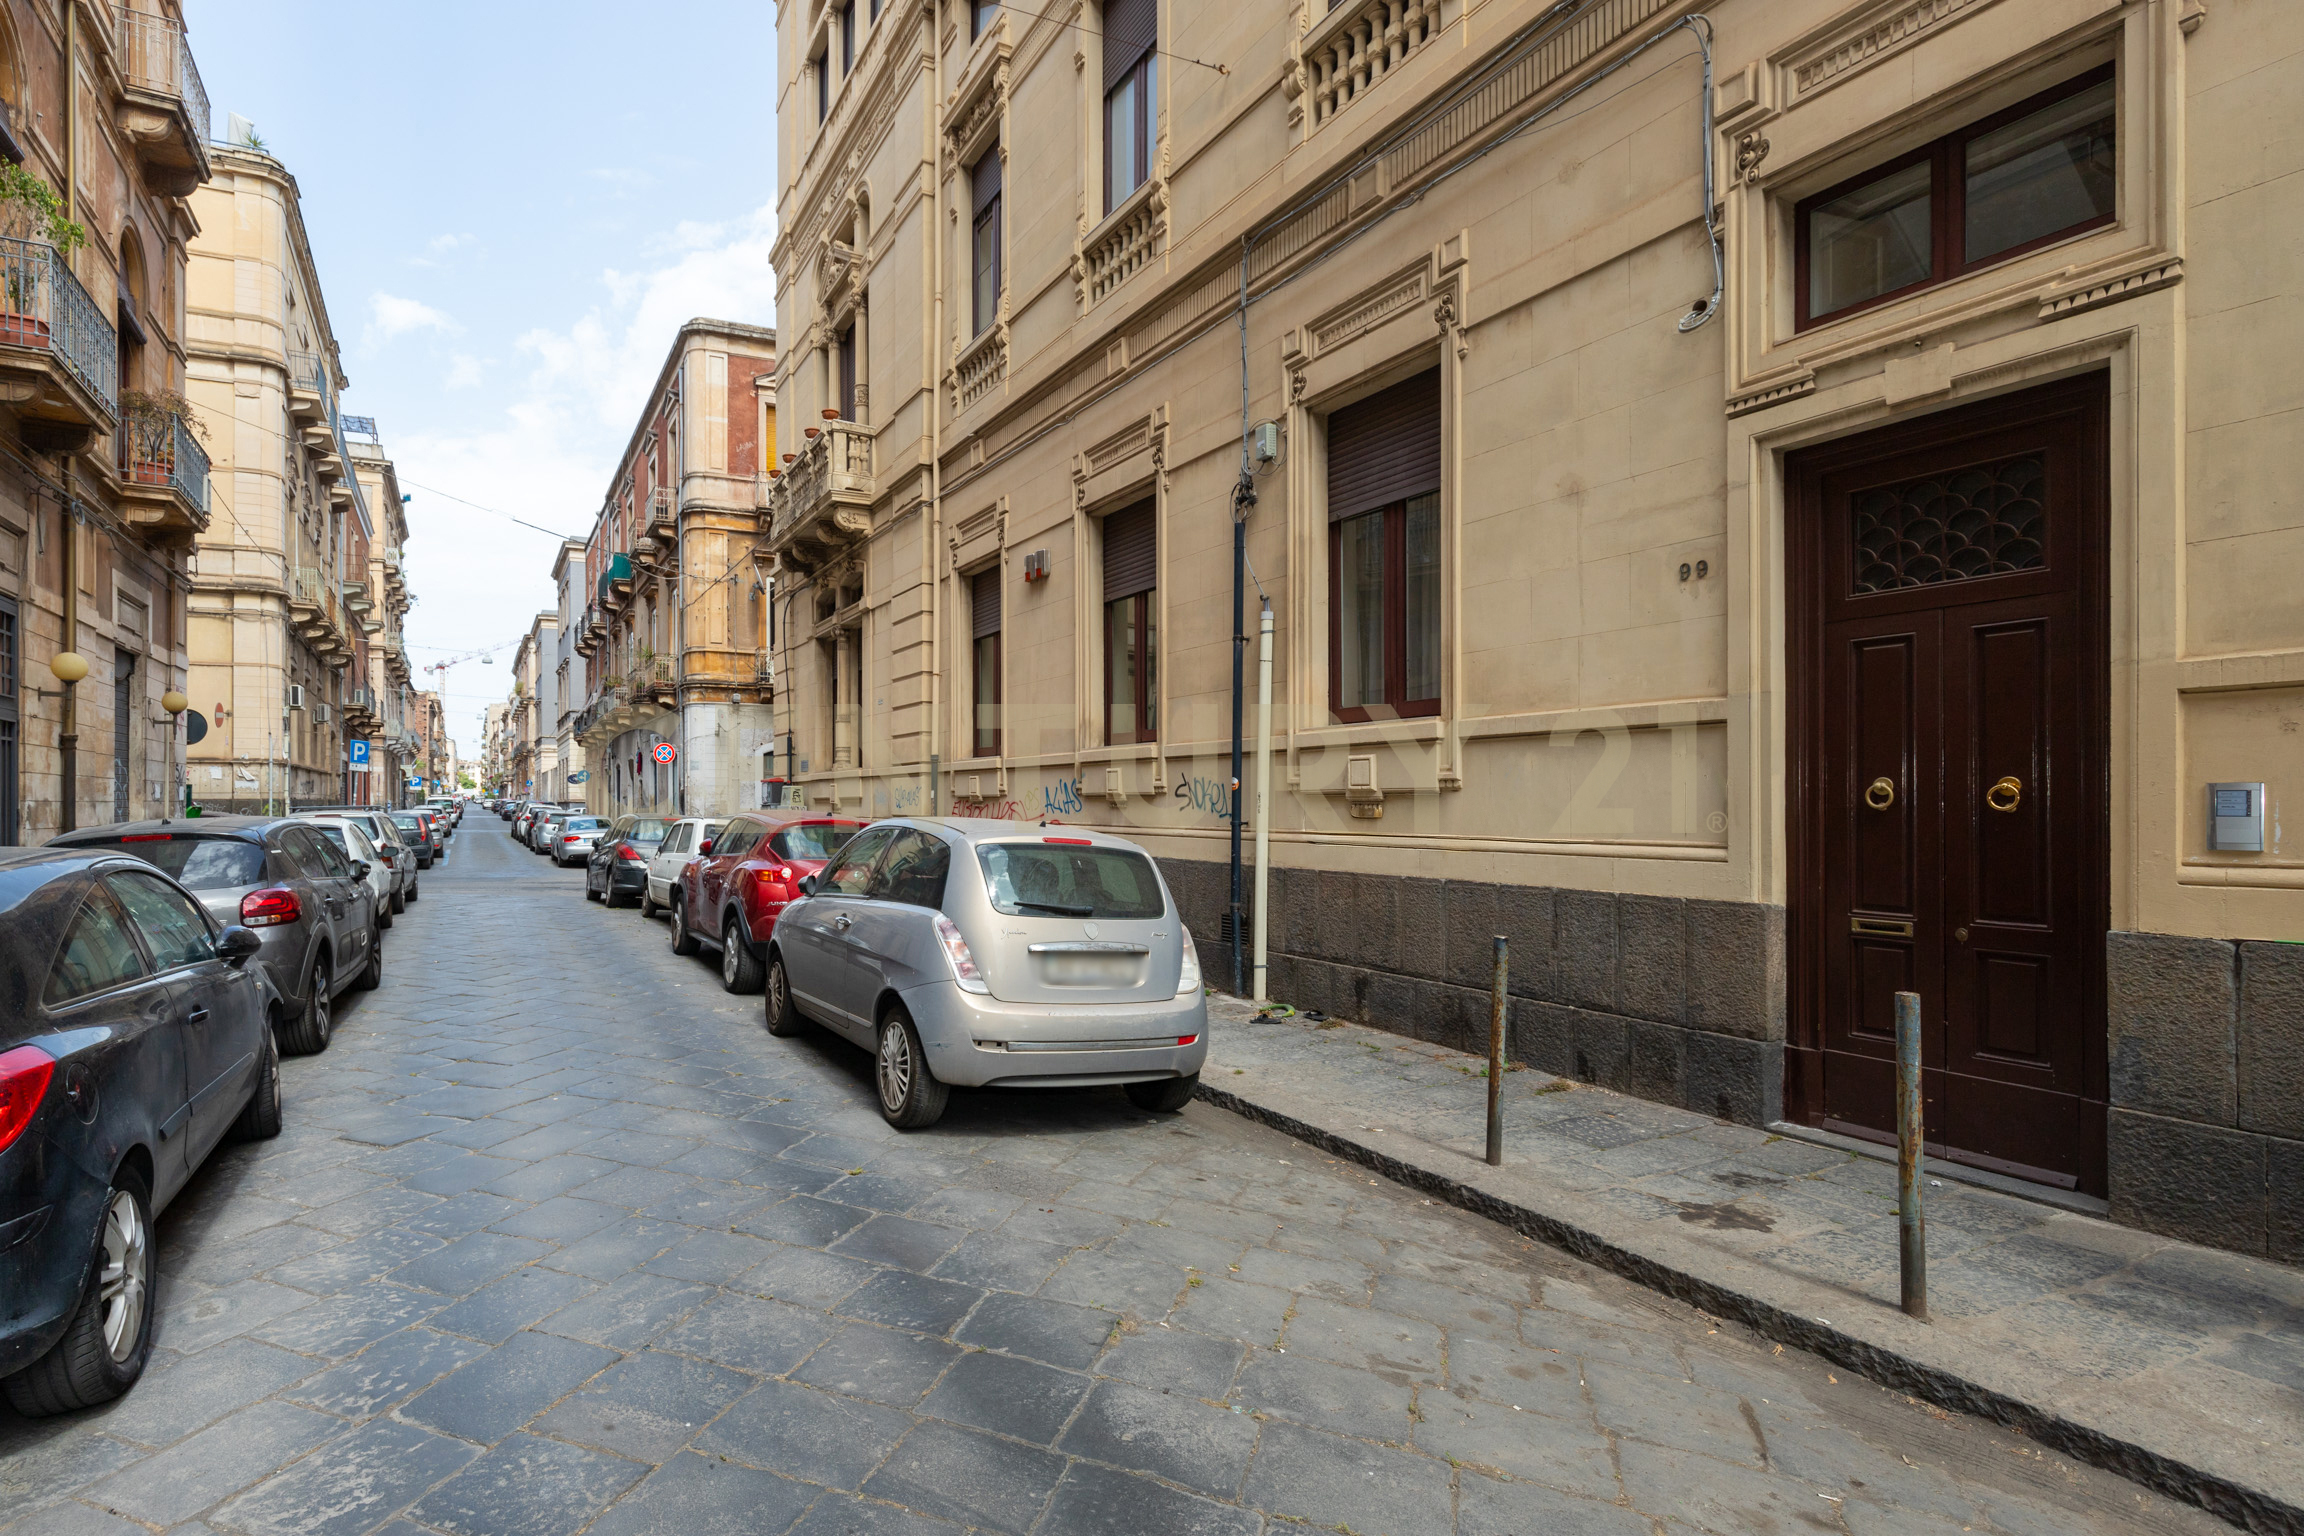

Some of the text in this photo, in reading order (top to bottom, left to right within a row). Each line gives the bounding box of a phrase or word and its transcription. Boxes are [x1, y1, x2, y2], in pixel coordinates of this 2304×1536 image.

[1680, 559, 1709, 582] 99
[353, 742, 366, 761] P
[412, 777, 420, 786] P
